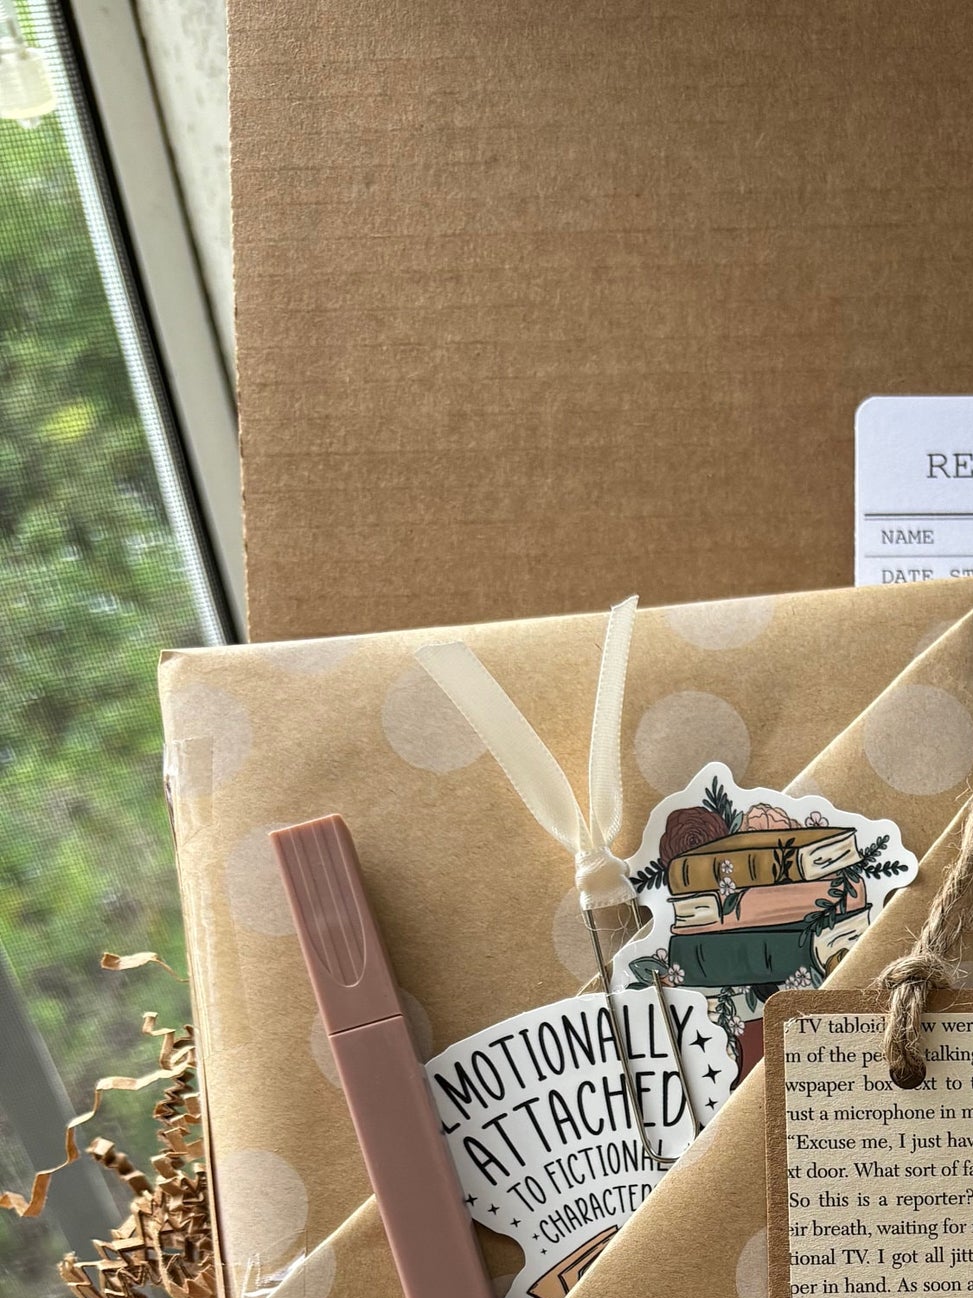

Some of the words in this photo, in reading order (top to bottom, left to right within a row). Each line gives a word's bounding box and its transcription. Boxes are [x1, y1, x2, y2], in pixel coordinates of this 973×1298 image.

[881, 530, 934, 545] NAME
[882, 569, 934, 584] DATE
[796, 1019, 822, 1033] TV
[807, 1046, 825, 1062] of
[829, 1046, 856, 1062] the
[434, 1004, 694, 1133] MOTIONALLY
[863, 1075, 893, 1091] box
[946, 1077, 962, 1090] to
[820, 1110, 829, 1120] a
[834, 1103, 935, 1125] microphone
[940, 1105, 956, 1119] in
[463, 1071, 686, 1186] ATTACHED
[861, 1138, 892, 1151] me,
[899, 1133, 905, 1148] I
[910, 1134, 942, 1153] just
[507, 1175, 547, 1212] TO
[544, 1139, 670, 1195] FICTIONAL
[807, 1162, 848, 1178] door.
[853, 1161, 900, 1177] What
[905, 1164, 937, 1177] sort
[942, 1160, 960, 1176] of
[790, 1193, 810, 1207] So
[819, 1191, 849, 1207] this
[857, 1193, 870, 1206] is
[879, 1196, 888, 1206] a
[896, 1188, 973, 1211] reporter?
[812, 1219, 872, 1238] breath,
[877, 1221, 938, 1240] waiting
[943, 1218, 967, 1234] for
[842, 1249, 869, 1264] TV.
[878, 1249, 885, 1264] I
[892, 1250, 918, 1269] got
[925, 1246, 944, 1263] all
[823, 1280, 839, 1293] in
[844, 1276, 890, 1293] hand.
[897, 1277, 917, 1292] As
[923, 1281, 961, 1292] soon
